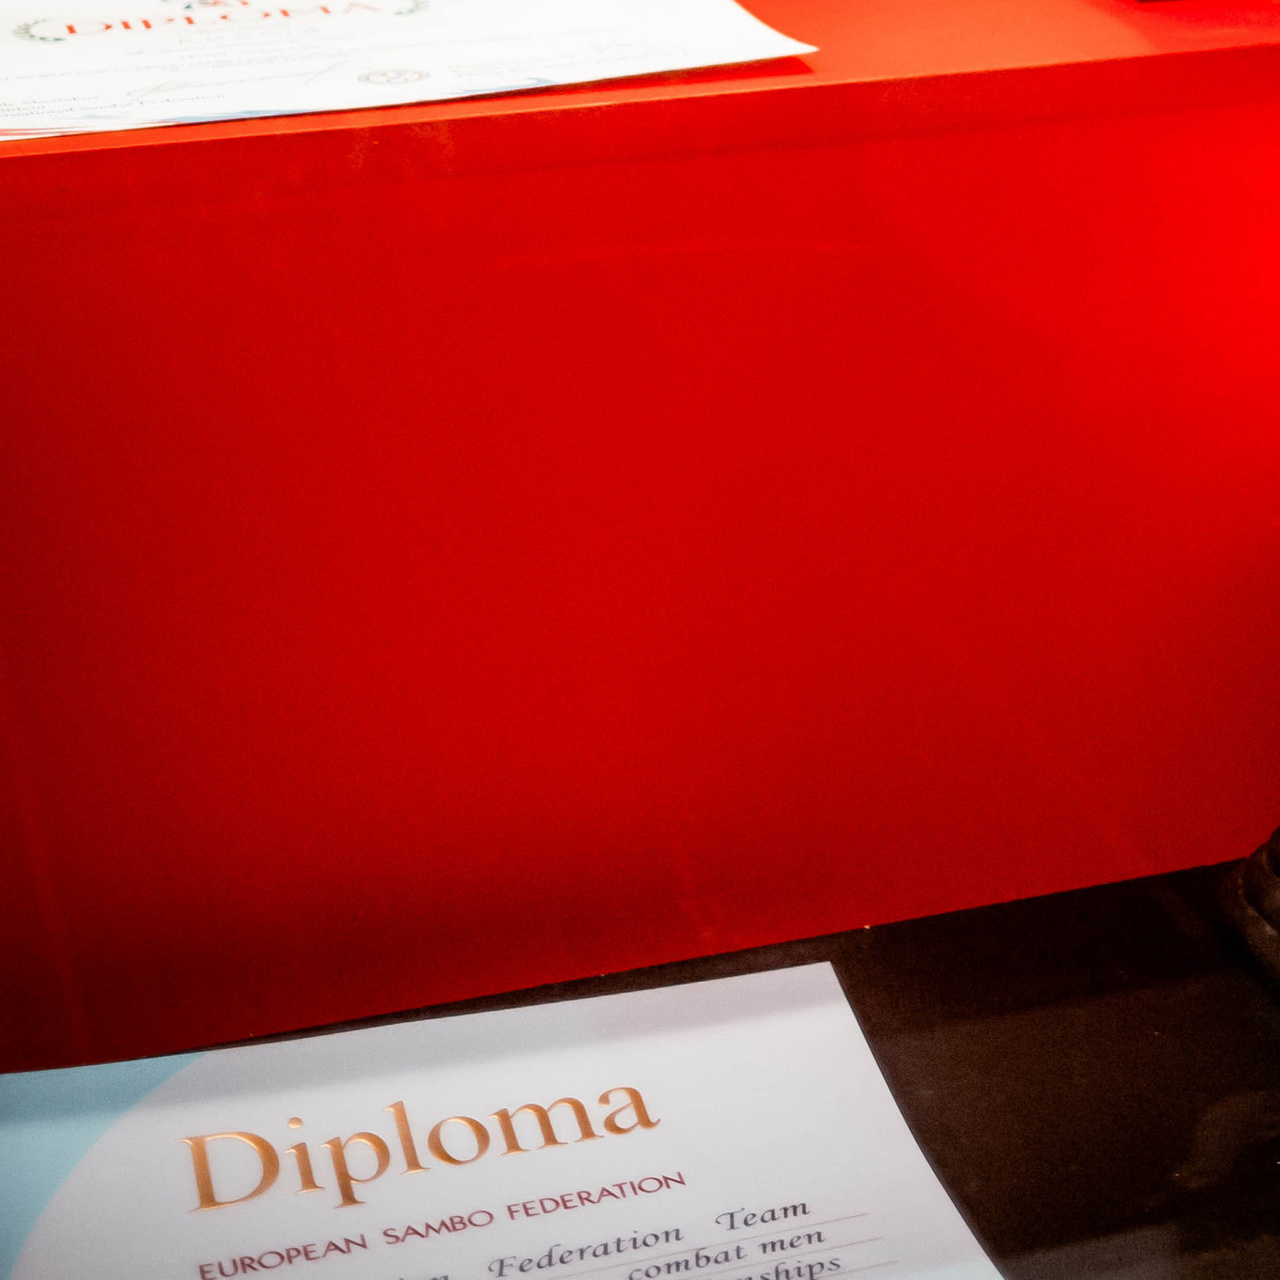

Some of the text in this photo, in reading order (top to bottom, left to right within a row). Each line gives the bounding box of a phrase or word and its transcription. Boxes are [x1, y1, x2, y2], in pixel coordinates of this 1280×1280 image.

[66, 2, 381, 36] DIPLOMA
[176, 1085, 662, 1213] Diploma
[198, 1171, 687, 1280] EUROPEAN SAMBO FEDERATION
[488, 1201, 811, 1278] Federation Team
[628, 1230, 826, 1280] combat men
